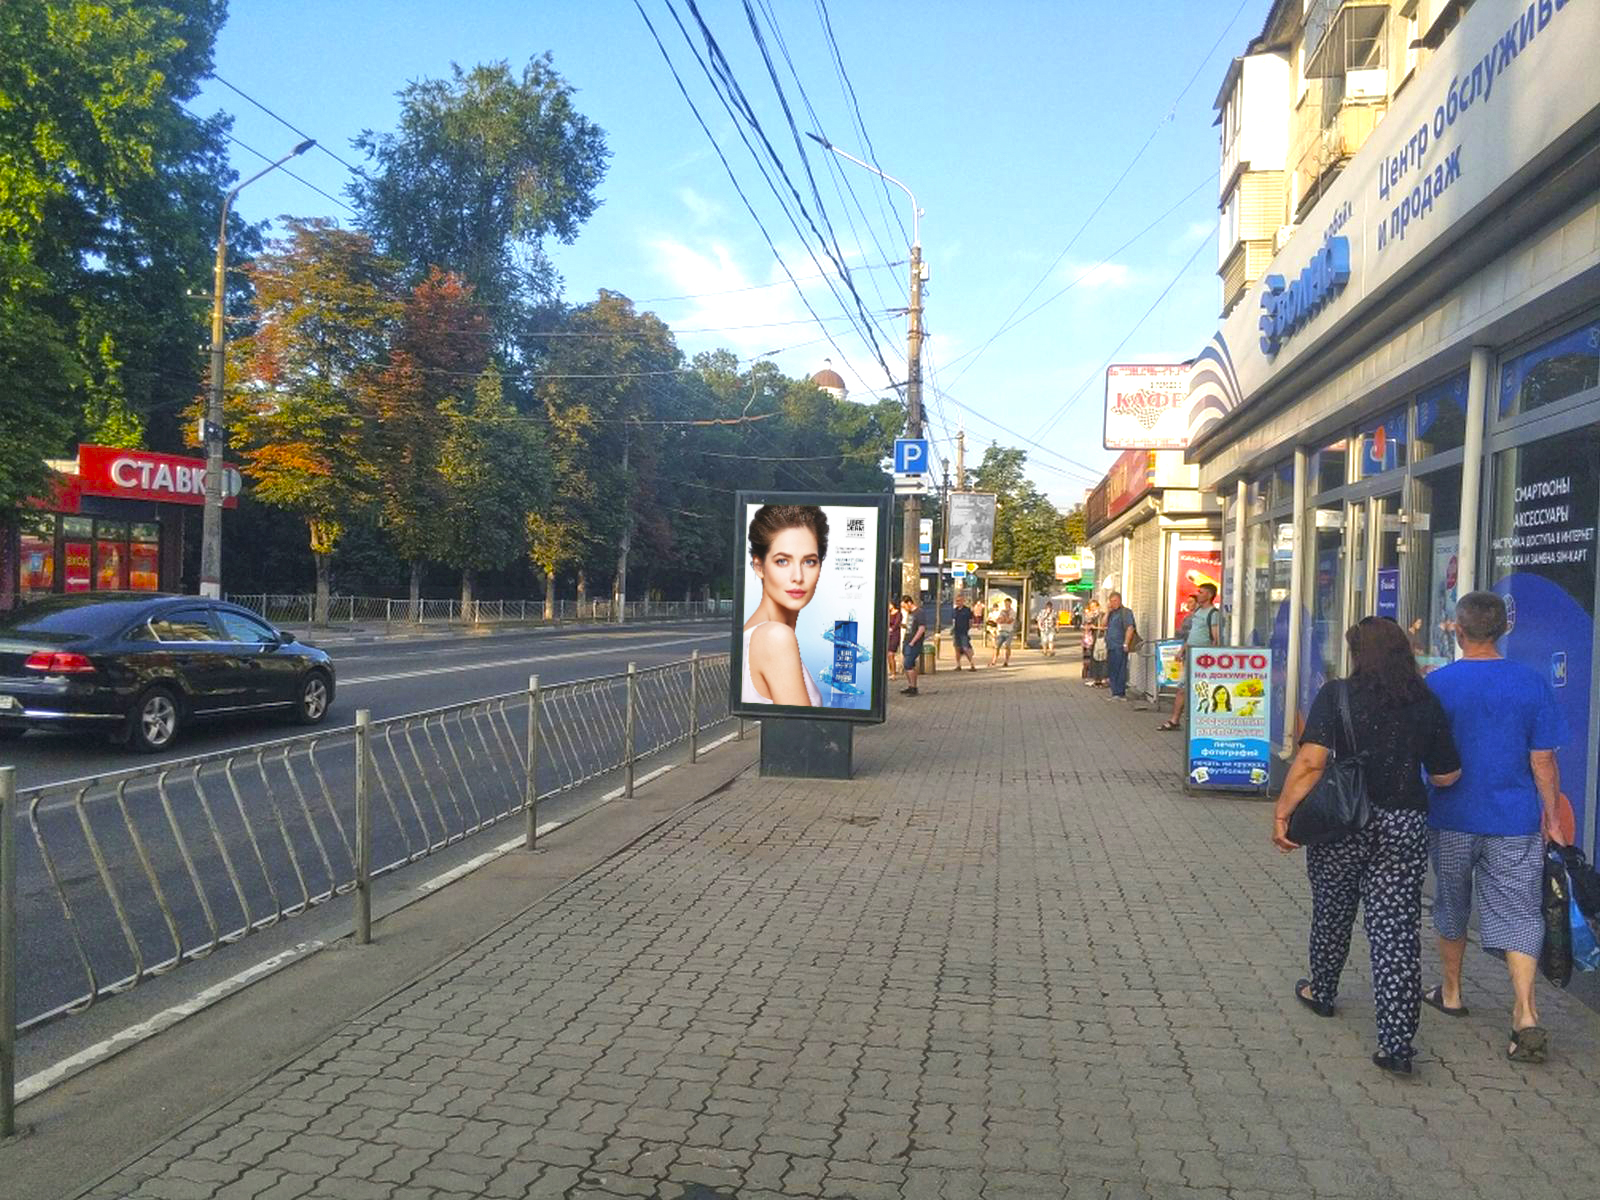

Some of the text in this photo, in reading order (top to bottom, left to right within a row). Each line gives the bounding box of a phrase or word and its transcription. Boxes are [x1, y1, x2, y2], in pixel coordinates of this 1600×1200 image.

[1378, 123, 1429, 201] Центр
[1377, 144, 1463, 252] и продаж
[1115, 392, 1184, 409] КАФЕ
[1514, 477, 1571, 502] СМАРТФОНЫ
[1514, 506, 1569, 526] АКСЕССУАРЫ
[1526, 532, 1555, 546] ДОСТУПА
[1561, 528, 1594, 543] ИНТЕРНЕТ
[66, 556, 90, 568] ВХОД
[1195, 653, 1268, 670] ФОТО
[1194, 671, 1268, 680] НА ДОКУМЕНТЫ
[1213, 741, 1247, 749] печать
